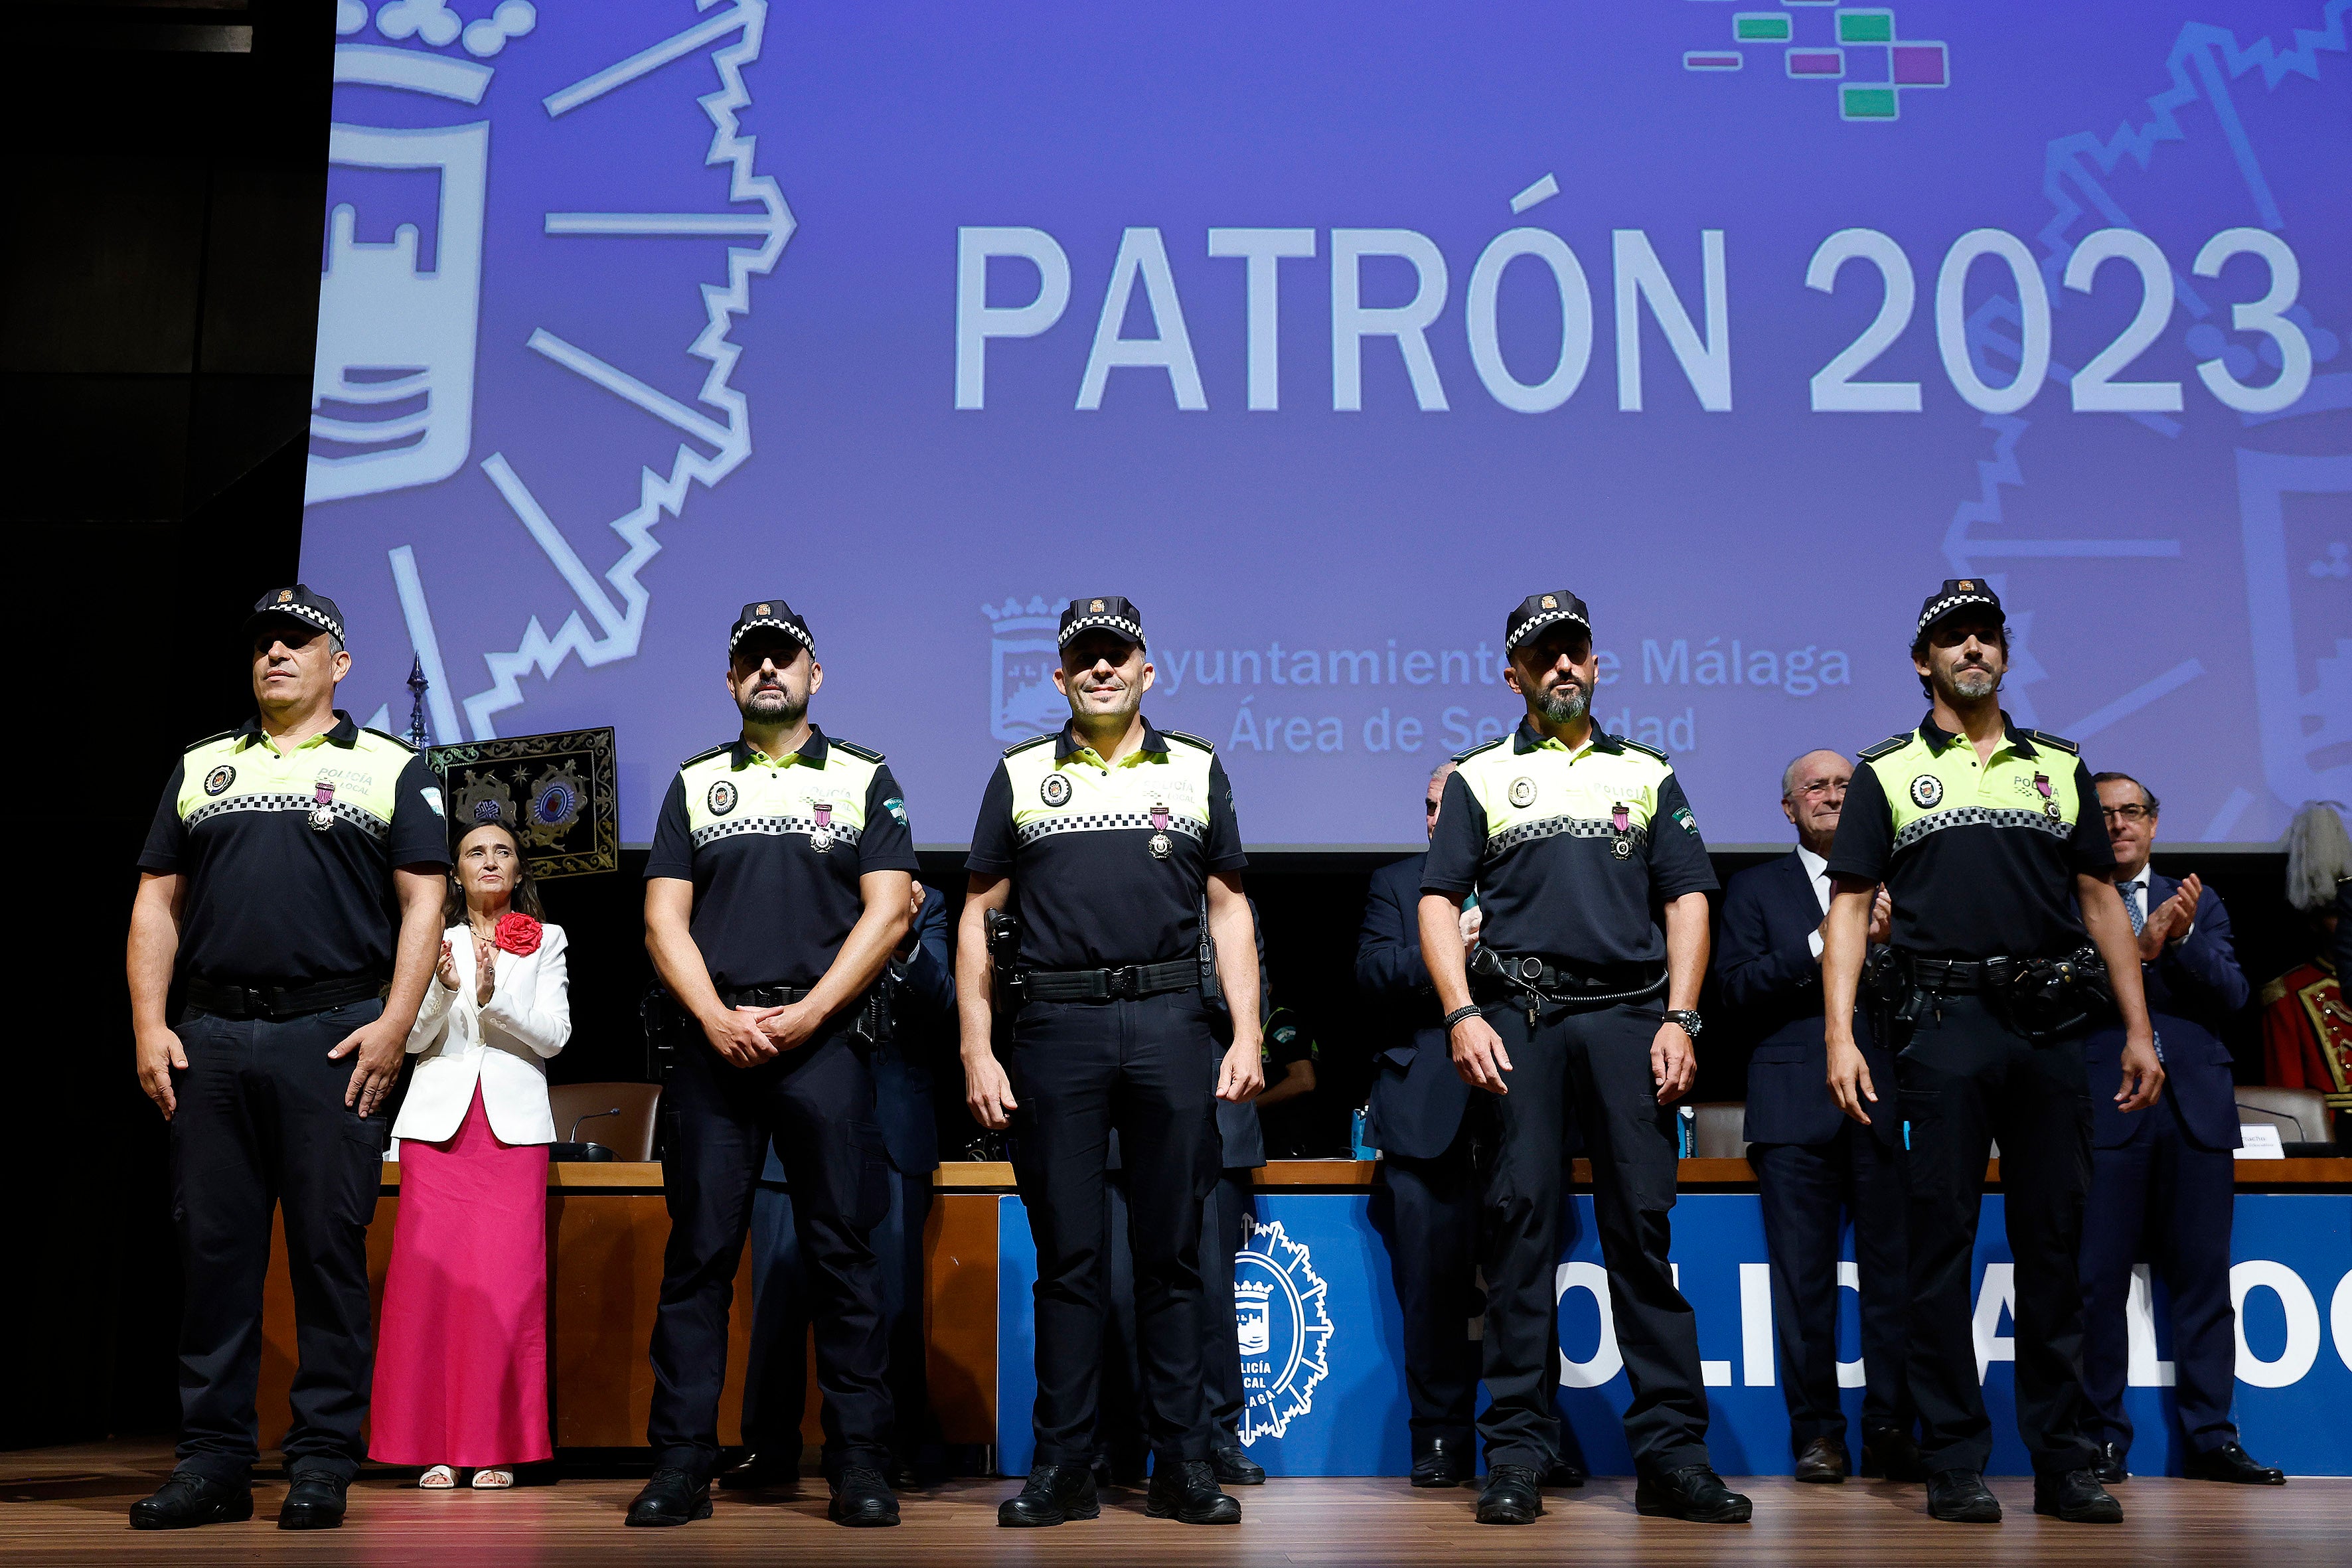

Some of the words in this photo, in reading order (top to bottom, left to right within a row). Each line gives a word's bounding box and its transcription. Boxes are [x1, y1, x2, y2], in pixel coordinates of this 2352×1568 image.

[955, 173, 1732, 414] PATRÓN
[1804, 227, 2313, 414] 2023
[1594, 650, 1621, 686] e
[1641, 636, 1851, 696] Málaga
[1227, 694, 1344, 752] Área
[1363, 706, 1424, 752] de
[1439, 706, 1695, 752] Sedad
[339, 782, 369, 796] LOCAL
[1241, 1360, 1271, 1373] LICÍA
[1243, 1377, 1267, 1388] CAL
